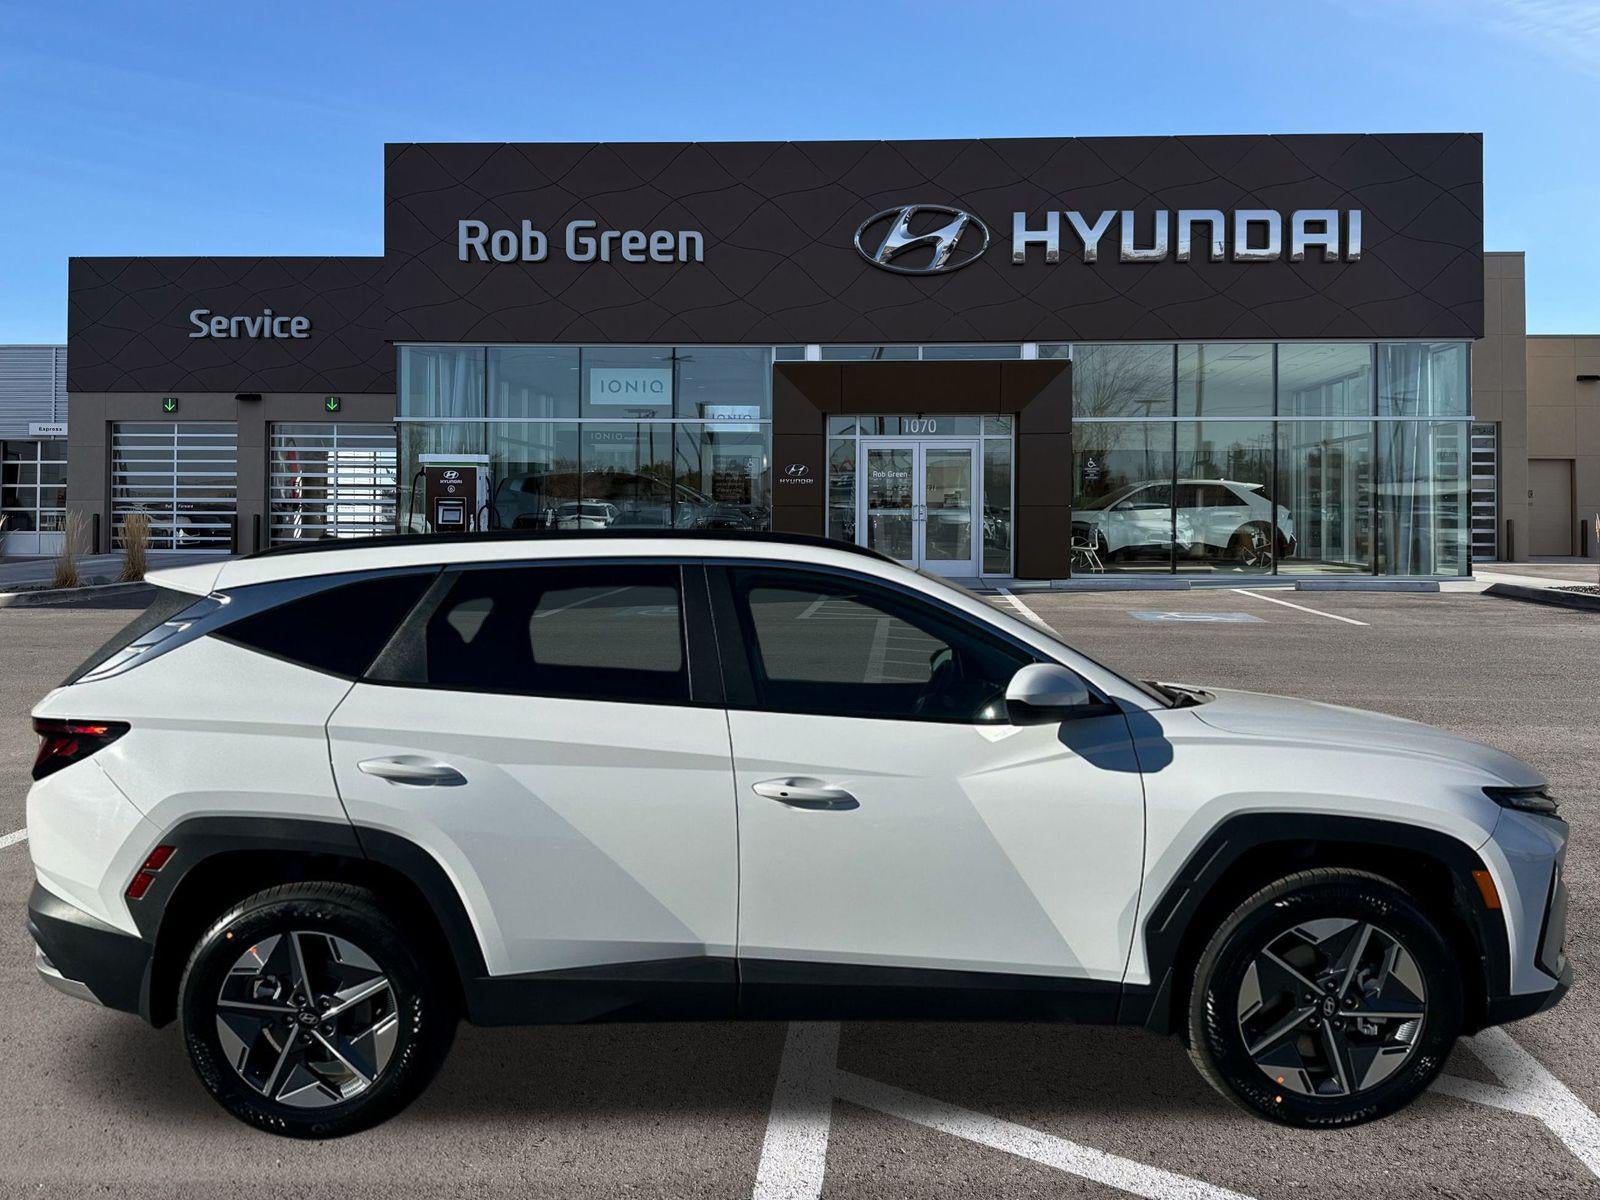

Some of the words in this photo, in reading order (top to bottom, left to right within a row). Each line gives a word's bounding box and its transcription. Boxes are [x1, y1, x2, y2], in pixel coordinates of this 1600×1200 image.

[458, 219, 548, 263] Rob
[565, 219, 704, 263] Green
[1011, 209, 1362, 264] HYUNDAI
[188, 308, 311, 339] Service
[600, 379, 664, 393] IONIQ
[903, 418, 937, 433] 1070
[590, 432, 623, 440] IONIQ
[872, 470, 886, 478] Rob
[887, 470, 908, 478] Green
